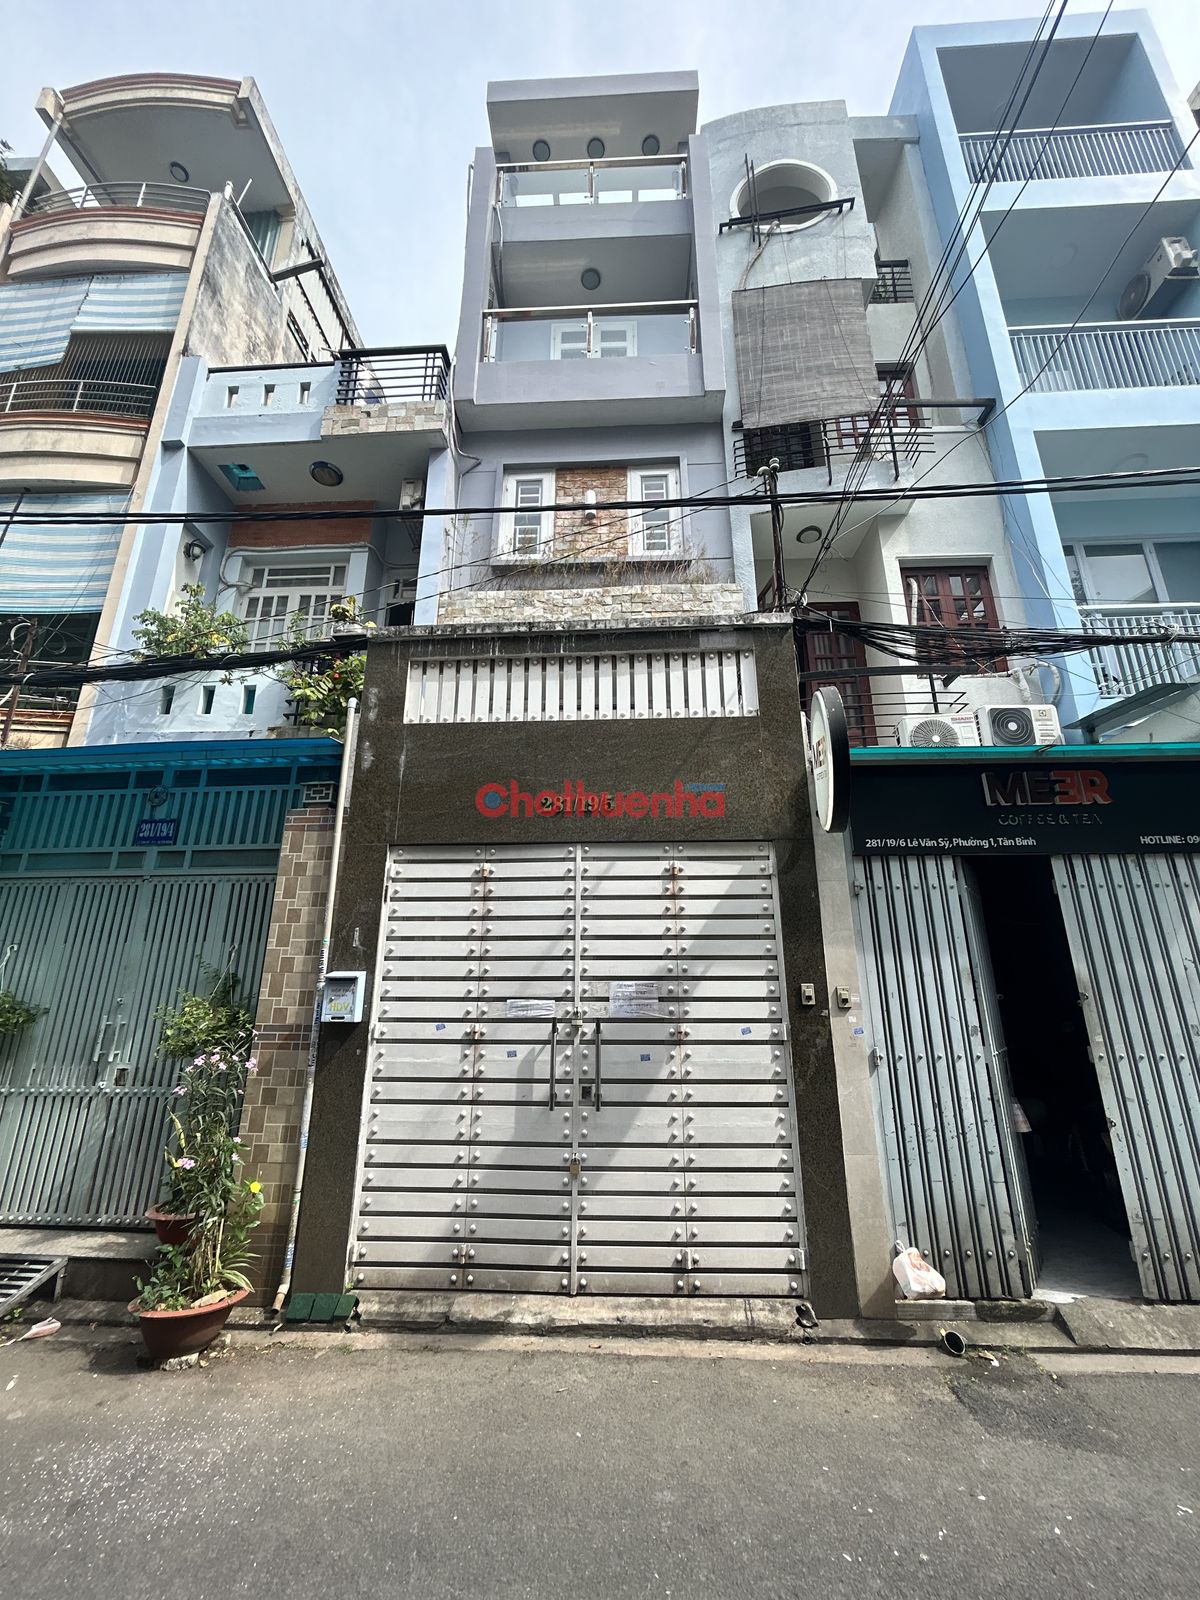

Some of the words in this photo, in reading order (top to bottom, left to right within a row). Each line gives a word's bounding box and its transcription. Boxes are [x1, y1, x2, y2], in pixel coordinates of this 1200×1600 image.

[1058, 814, 1069, 825] &
[866, 838, 906, 847] 281/19/6
[919, 837, 937, 847] Văn
[953, 836, 989, 849] Phường
[997, 837, 1014, 846] Tân
[1015, 836, 1037, 846] Bình
[1139, 835, 1185, 844] HOTLINE:
[1186, 835, 1200, 844] 09
